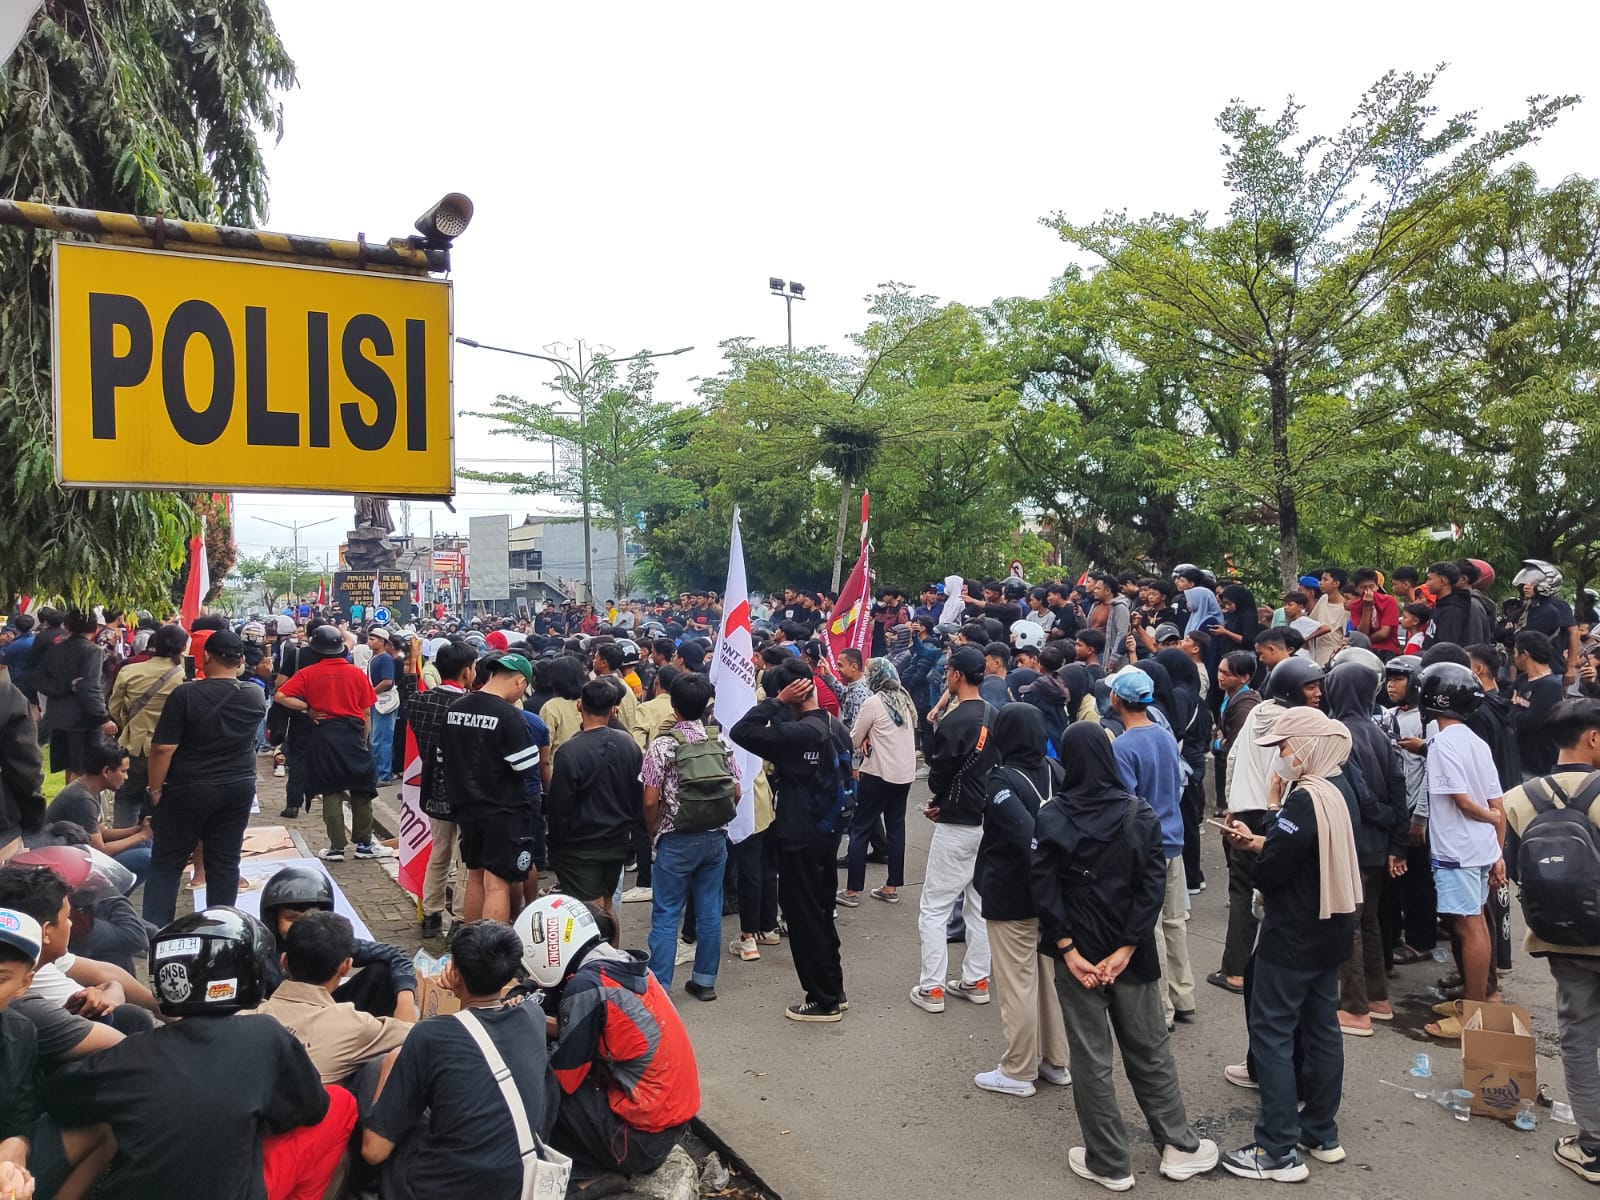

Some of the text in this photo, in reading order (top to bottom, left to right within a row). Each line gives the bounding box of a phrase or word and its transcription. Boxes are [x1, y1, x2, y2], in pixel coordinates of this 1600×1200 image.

[89, 292, 427, 451] POLISI
[722, 642, 742, 660] ONT
[447, 711, 499, 730] DEFEATED
[547, 917, 560, 968] KINGKONG
[160, 964, 186, 983] SNSB
